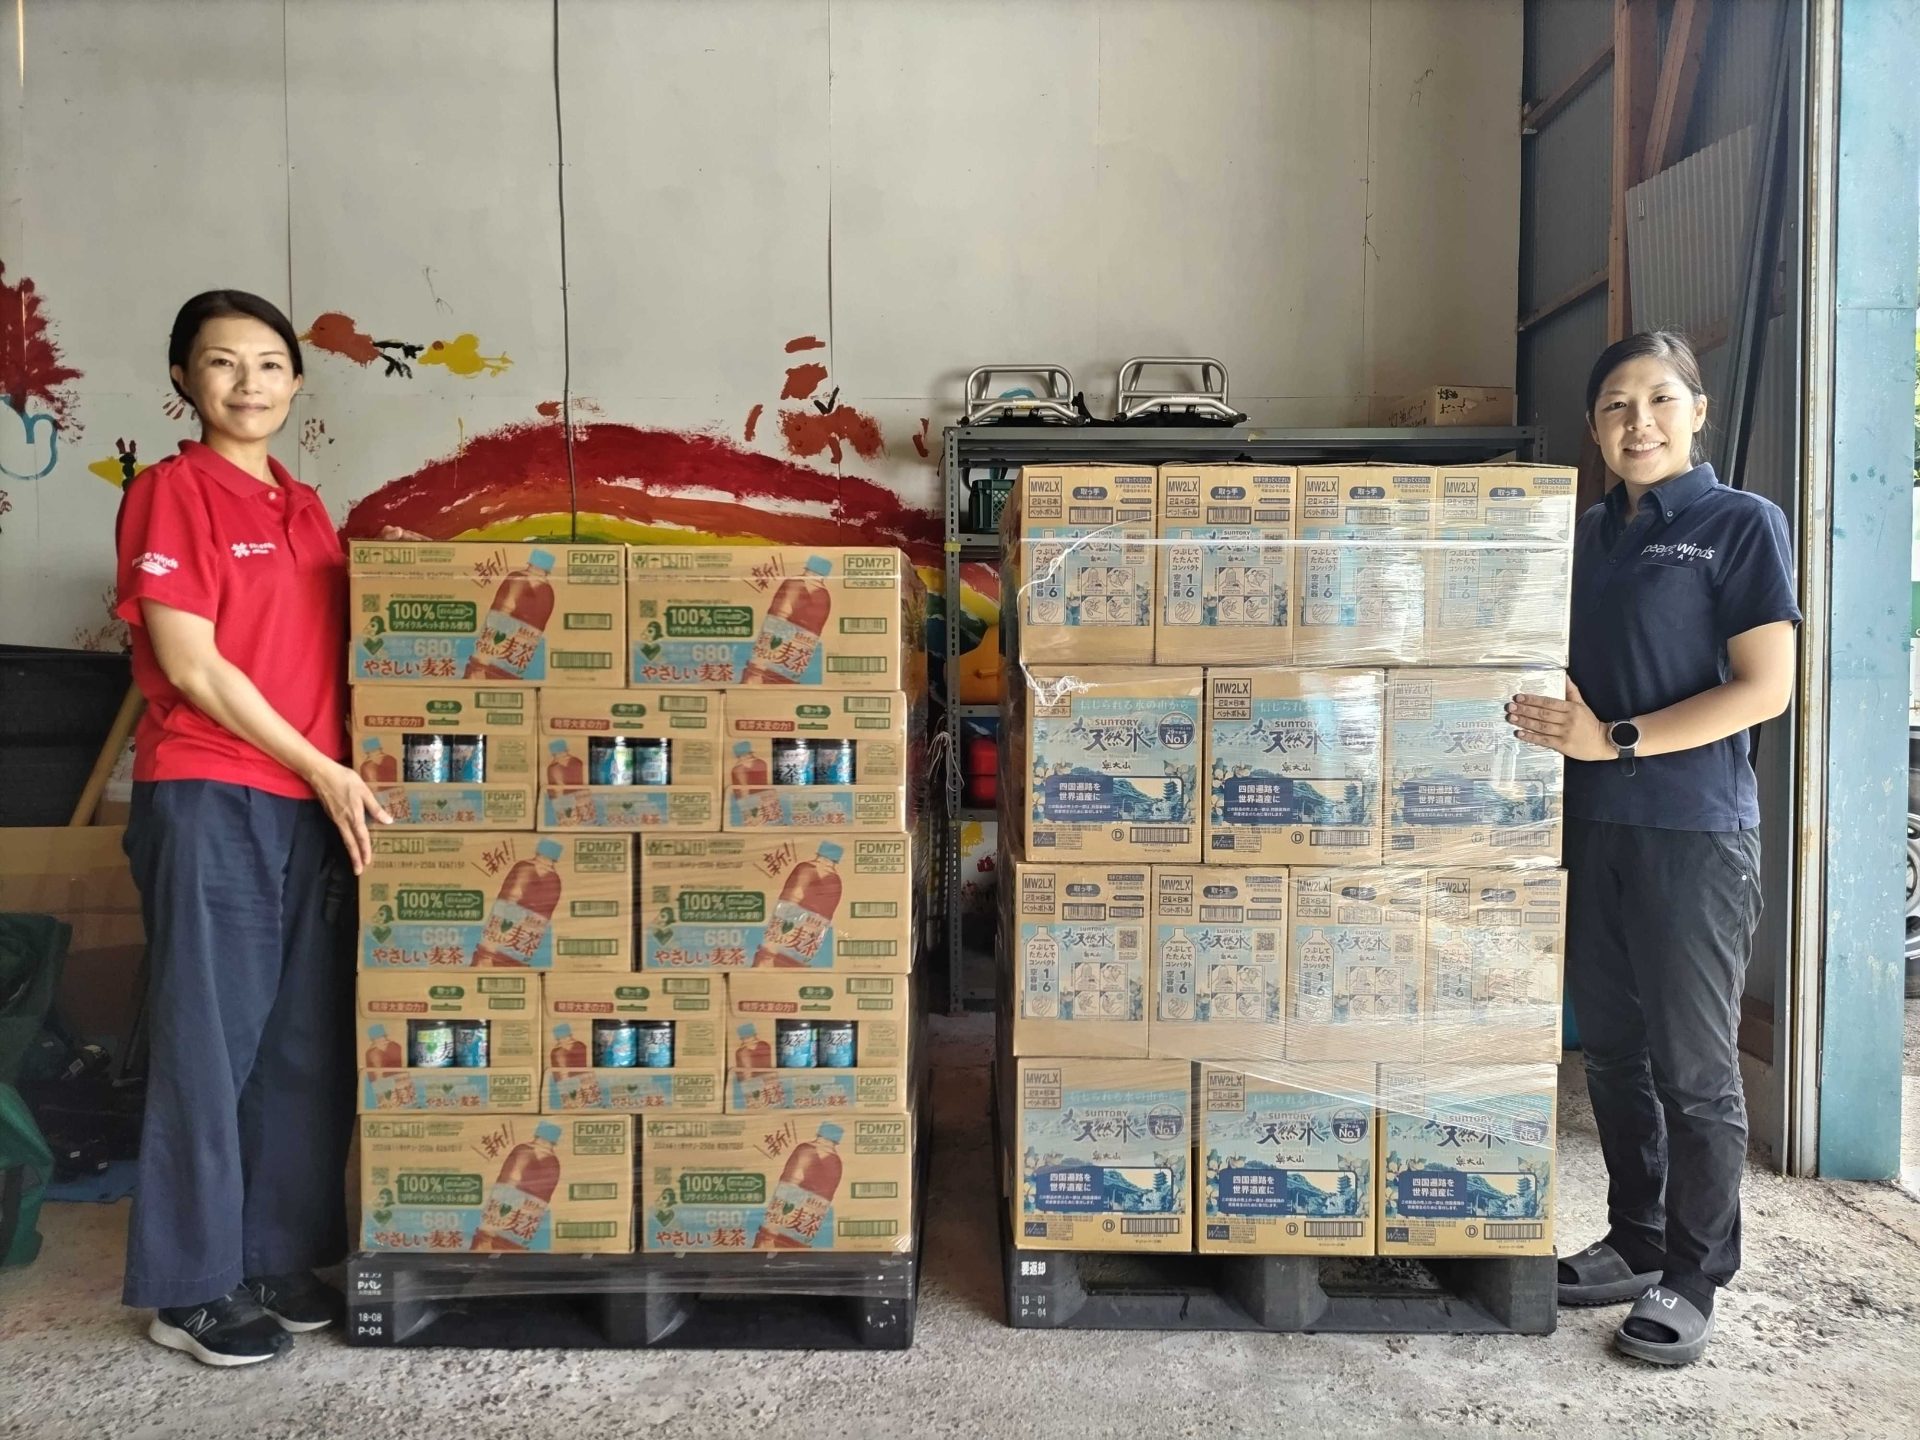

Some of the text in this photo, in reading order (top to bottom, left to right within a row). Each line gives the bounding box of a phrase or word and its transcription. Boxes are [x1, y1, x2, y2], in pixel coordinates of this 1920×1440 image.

[1031, 481, 1060, 492] MW2LX
[1169, 482, 1197, 492] MW2LX
[1307, 482, 1336, 492] MW2LX
[1447, 482, 1476, 493] MW2LX
[572, 553, 615, 564] FDM7P
[848, 557, 890, 567] FDM7P
[1051, 574, 1056, 583] 1
[1187, 574, 1193, 584] 1
[1325, 574, 1330, 584] 1
[1049, 587, 1057, 597] 6
[1186, 587, 1194, 598] 6
[1324, 588, 1332, 598] 6
[1462, 589, 1470, 599] 6
[393, 603, 435, 620] 100%
[670, 609, 712, 625] 100%
[364, 658, 456, 676] やさしい麦茶
[642, 664, 733, 681] やさしい麦茶
[1216, 683, 1248, 694] MW2LX
[1084, 728, 1151, 752] 天然水
[1166, 734, 1187, 743] No.1
[579, 842, 621, 852] FDM7P
[859, 843, 901, 854] FDM7P
[1024, 878, 1053, 888] MW2LX
[1162, 880, 1190, 891] MW2LX
[402, 892, 443, 908] 100%
[683, 894, 724, 910] 100%
[1074, 933, 1113, 946] 天然水
[374, 947, 463, 965] やさしい麦茶
[655, 949, 745, 965] やさしい麦茶
[1044, 969, 1049, 978] 1
[1180, 971, 1185, 980] 1
[1042, 982, 1051, 992] 6
[1179, 983, 1187, 994] 6
[1455, 988, 1464, 997] 6
[860, 1078, 893, 1086] FDM7P
[1027, 1073, 1058, 1084] MW2LX
[1210, 1076, 1242, 1086] MW2LX
[577, 1124, 621, 1134] FDM7P
[859, 1124, 901, 1134] FDM7P
[1074, 1122, 1141, 1143] 天然水
[1155, 1125, 1176, 1134] No.1
[1257, 1123, 1325, 1145] 天然水
[1339, 1128, 1360, 1138] No.1
[1520, 1132, 1541, 1141] No.1
[401, 1176, 442, 1192] 100%
[684, 1176, 725, 1192] 100%
[1050, 1183, 1091, 1191] 世界遺産に
[1233, 1186, 1274, 1194] 世界遺産に
[1412, 1188, 1454, 1197] 世界遺産に
[374, 1231, 463, 1248] やさしい麦茶
[656, 1228, 746, 1246] やさしい麦茶
[1021, 1261, 1046, 1275] 要返却
[358, 1326, 382, 1335] P-04
